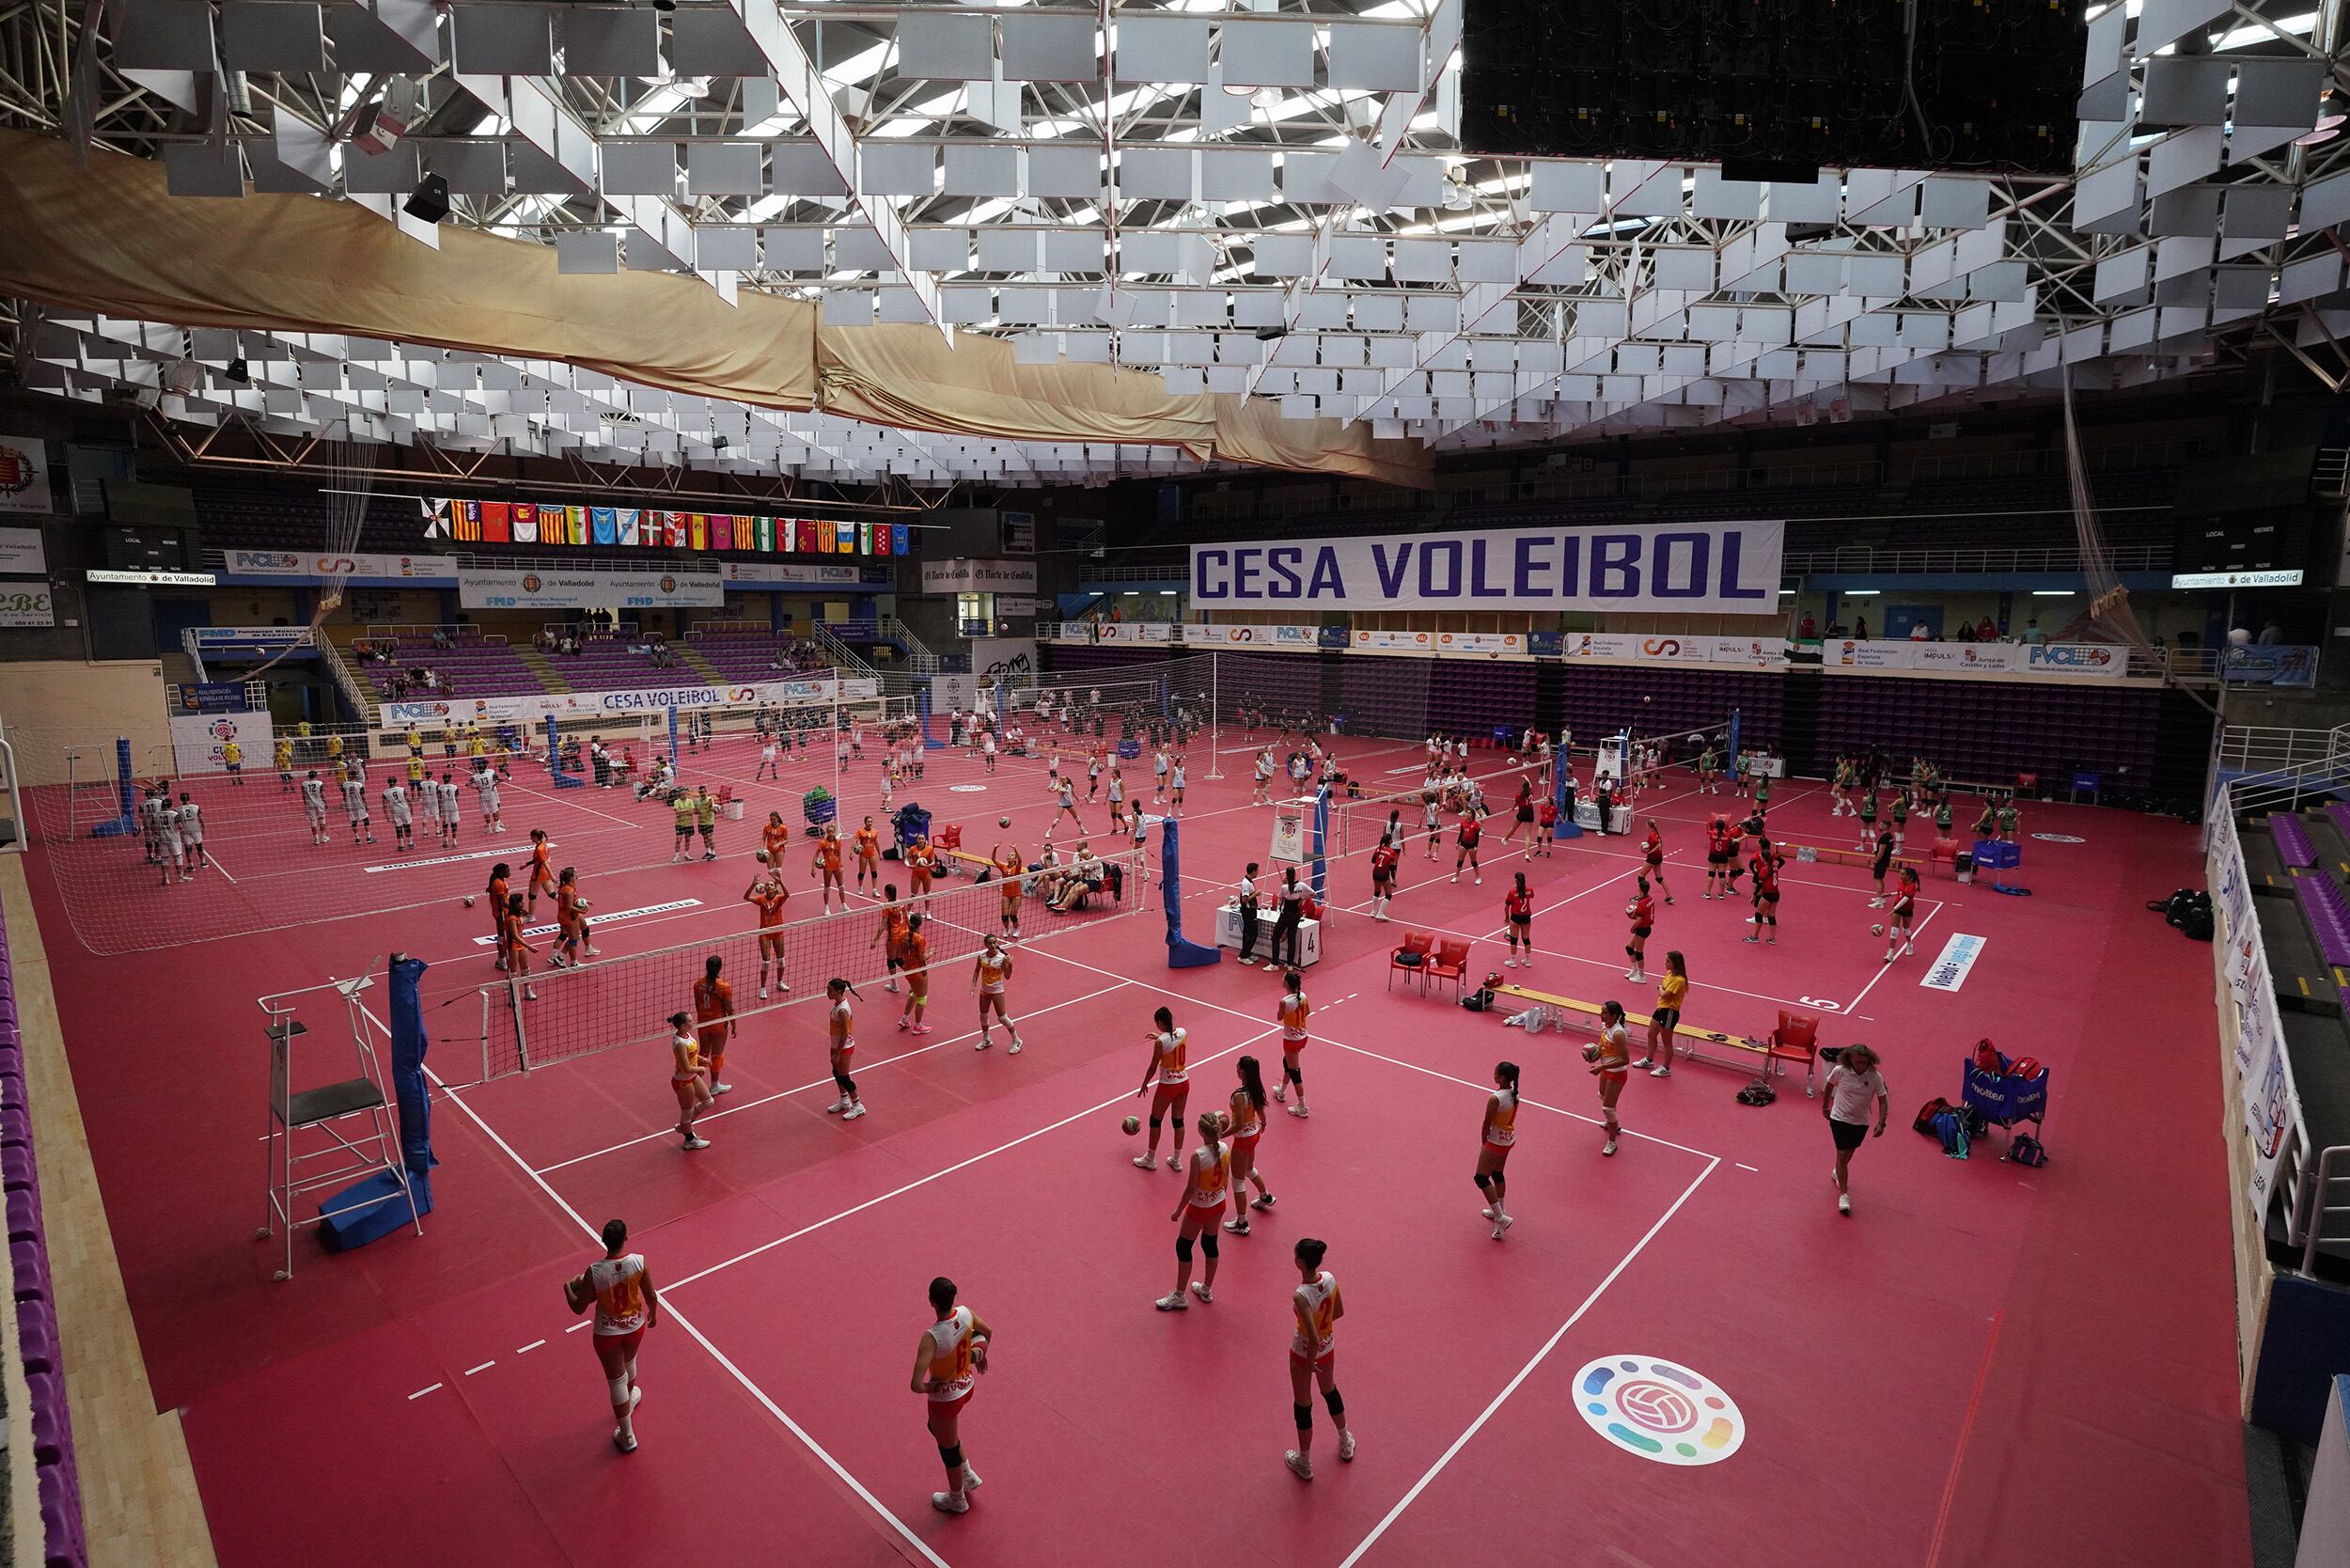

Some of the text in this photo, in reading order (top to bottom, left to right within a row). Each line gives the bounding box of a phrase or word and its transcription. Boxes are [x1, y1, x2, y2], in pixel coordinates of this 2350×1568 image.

[1198, 531, 1766, 599] CESA VOLEIBOL
[89, 572, 147, 581] Ayuntamiento
[976, 570, 1033, 580] El Norte de Castilla
[2174, 576, 2225, 587] Ayuntamiento
[2254, 572, 2298, 583] Valladolid
[464, 578, 516, 588] Ayuntamiento
[610, 581, 654, 589] Ayuntamiento
[486, 597, 517, 606] FMD
[627, 597, 653, 605] FMD
[199, 629, 236, 637] FMD
[2029, 647, 2084, 665] FVCL
[604, 694, 644, 711] CESA
[391, 703, 431, 719] FVCL
[307, 783, 317, 792] 12
[480, 776, 489, 786] 13
[159, 815, 169, 825] 10
[185, 808, 192, 819] 2
[1942, 809, 1950, 821] 2
[1715, 840, 1722, 852] 6
[1378, 854, 1384, 868] 7
[1772, 872, 1778, 886] 8
[591, 900, 695, 923] Constancia
[1520, 900, 1528, 913] 2
[1308, 932, 1314, 953] 4
[1928, 964, 1960, 987] Voleibol
[1799, 996, 1841, 1010] 5
[1173, 1043, 1186, 1069] 10
[1971, 1082, 2005, 1102] molten
[613, 1282, 628, 1315] 8
[1320, 1296, 1332, 1331] 2
[955, 1338, 967, 1374] 6
